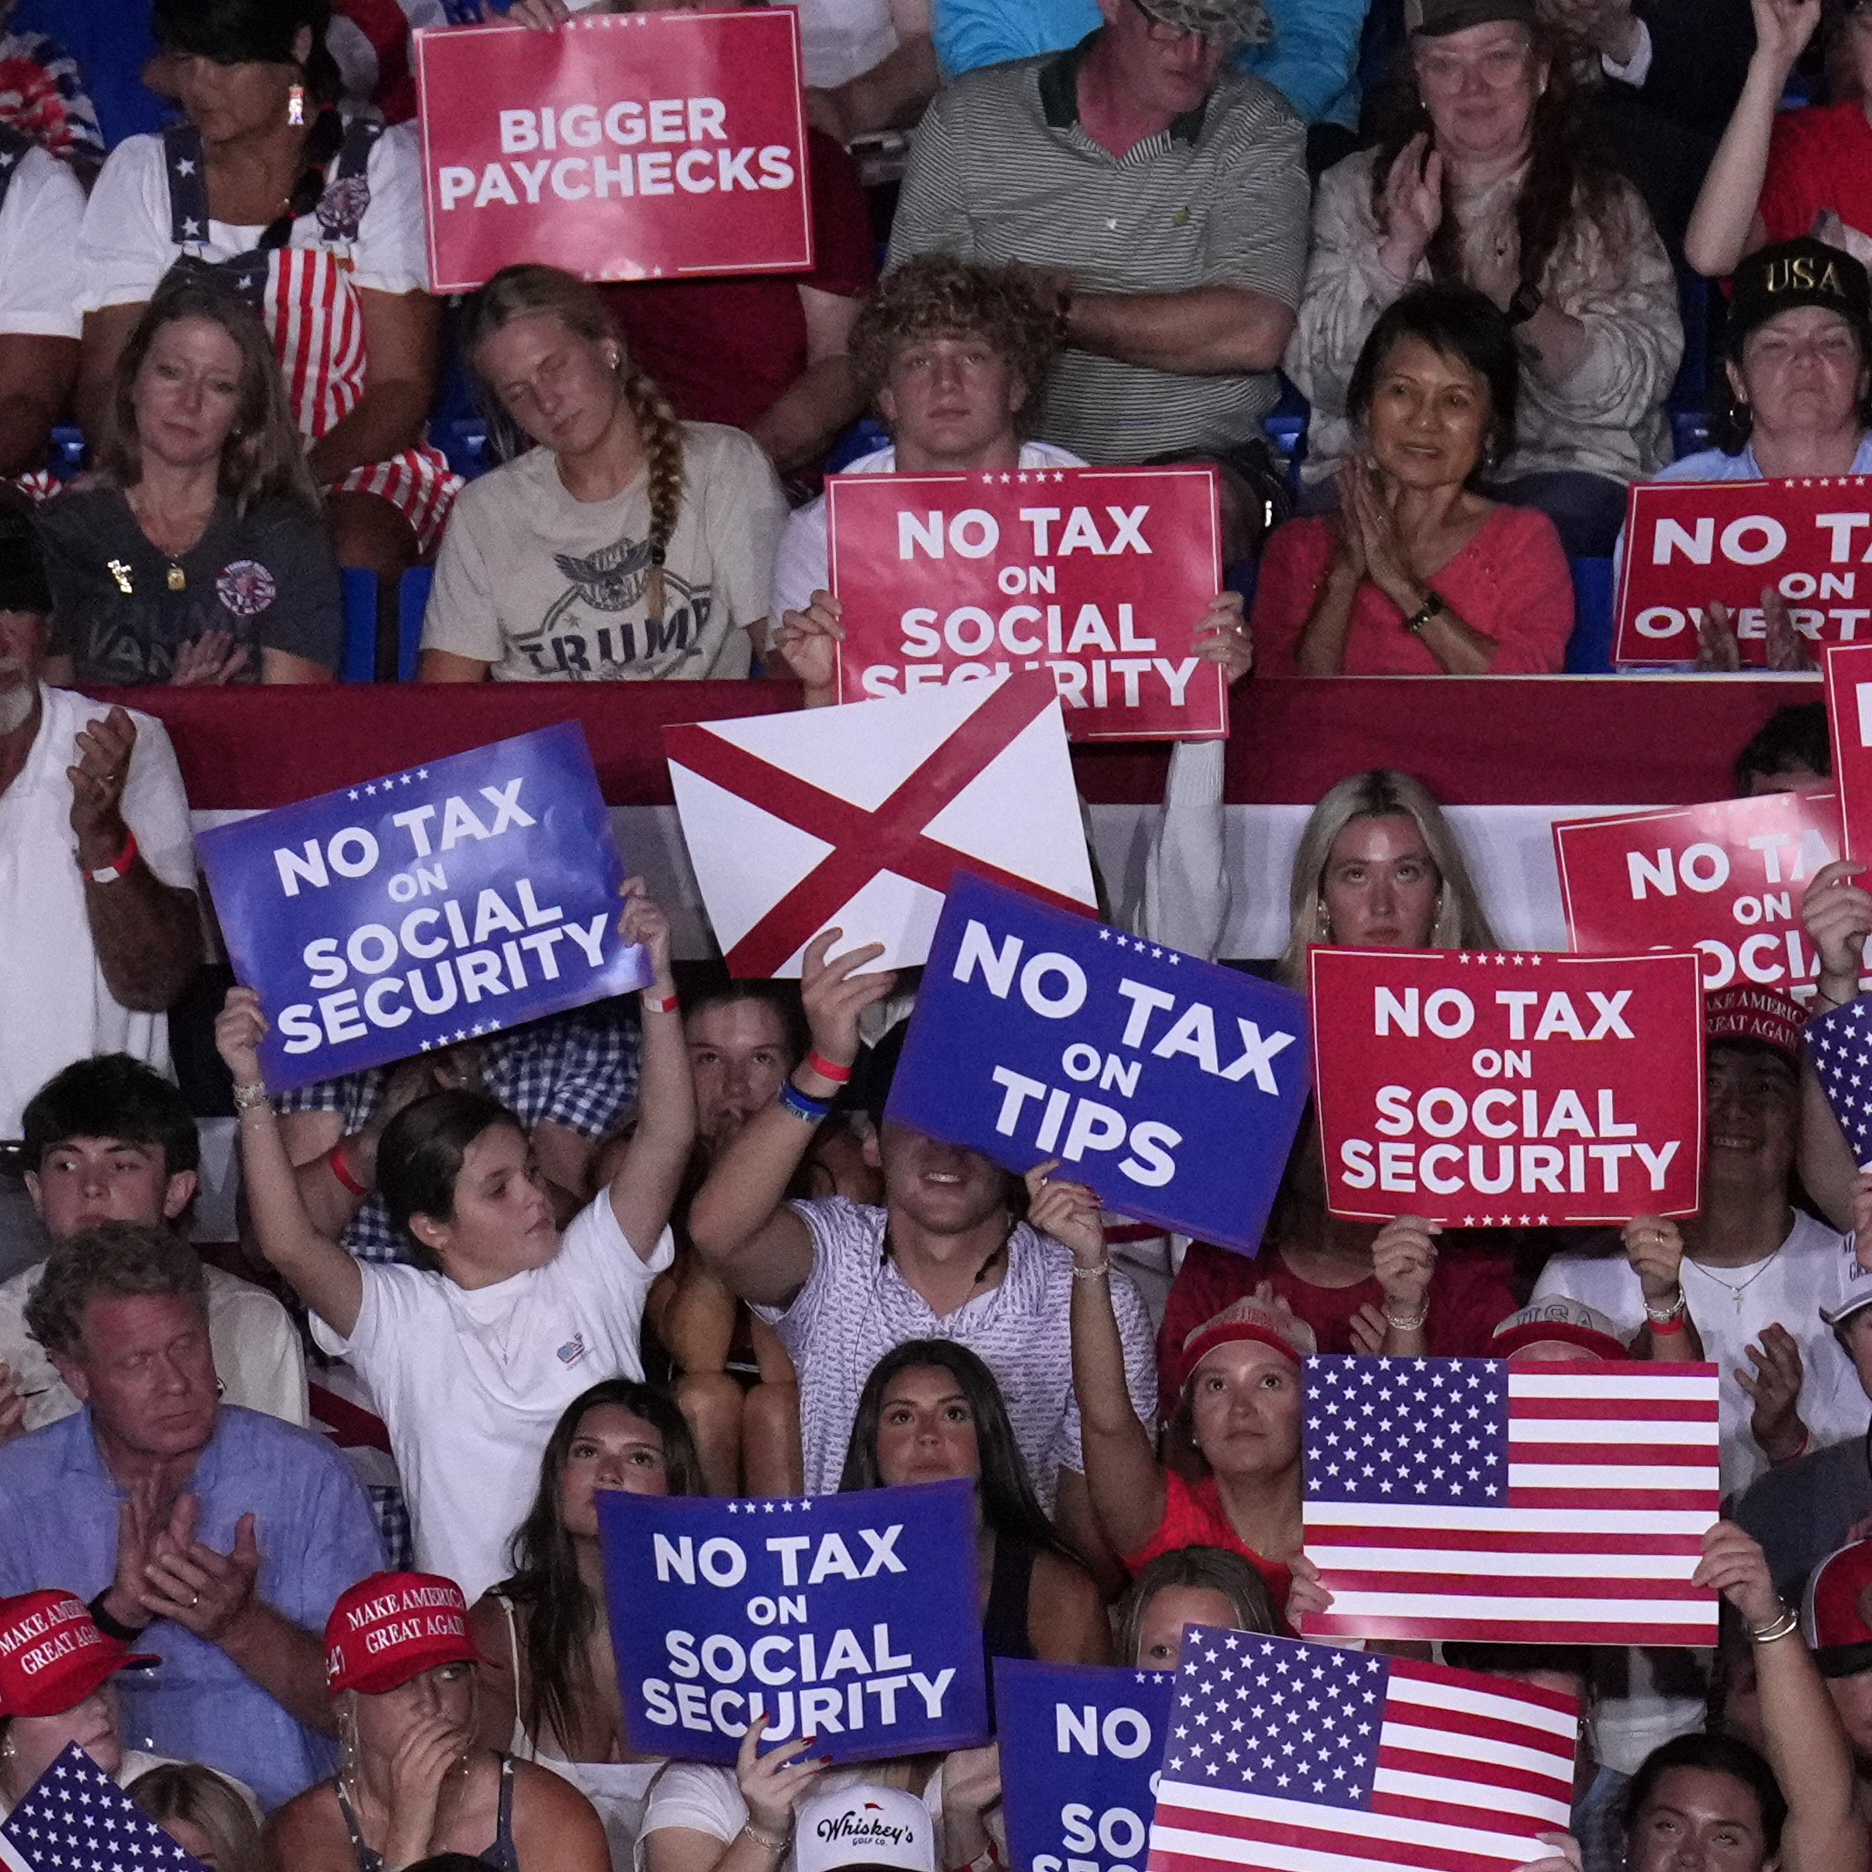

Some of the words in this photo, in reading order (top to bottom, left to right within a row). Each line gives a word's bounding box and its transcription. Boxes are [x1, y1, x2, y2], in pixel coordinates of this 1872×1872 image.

[499, 95, 726, 154] BIGGER
[437, 145, 796, 209] PAYCHECKS
[1766, 256, 1847, 298] USA
[898, 508, 1001, 559] NO
[1019, 504, 1153, 556] TAX
[1652, 514, 1787, 566] NO
[998, 564, 1055, 595] ON
[1779, 571, 1855, 600] ON
[901, 603, 1157, 658] SOCIAL
[273, 825, 380, 897] NO
[393, 777, 536, 859] TAX
[387, 862, 448, 903] ON
[1626, 844, 1730, 900] NO
[302, 877, 564, 989] SOCIAL
[1733, 892, 1792, 926] ON
[275, 912, 609, 1055] SECURITY
[951, 918, 1089, 1021] NO
[1117, 977, 1296, 1097] TAX
[1374, 987, 1476, 1039] NO
[1494, 989, 1636, 1041] TAX
[1062, 1042, 1142, 1099] ON
[1471, 1050, 1533, 1080] ON
[991, 1065, 1184, 1188] TIPS
[1373, 1084, 1638, 1138] SOCIAL
[1340, 1139, 1681, 1196] SECURITY
[653, 1534, 747, 1589] NO
[767, 1524, 907, 1588] TAX
[345, 1595, 402, 1632] MAKE
[364, 1616, 422, 1655] GREAT
[747, 1594, 808, 1627] ON
[19, 1639, 78, 1676] GREAT
[665, 1622, 913, 1685] SOCIAL
[644, 1666, 958, 1744] SECURITY
[1055, 1702, 1153, 1758] NO
[815, 1809, 915, 1848] Whiskey's
[852, 1836, 873, 1847] GOLF
